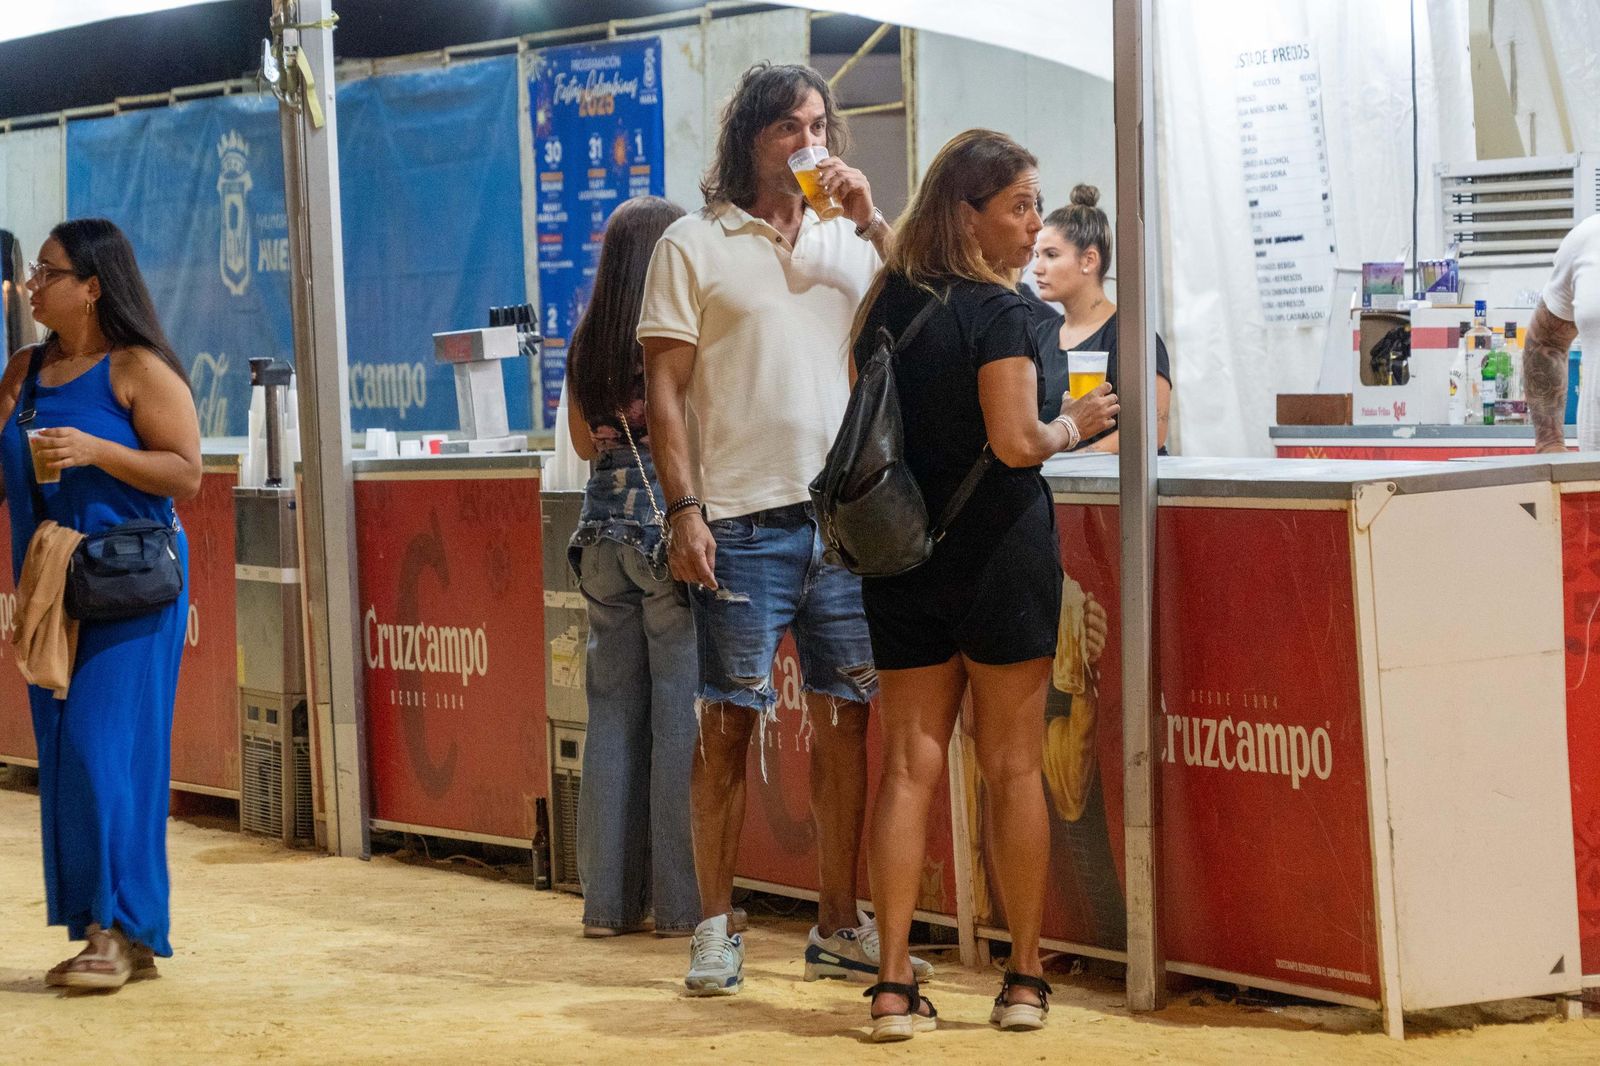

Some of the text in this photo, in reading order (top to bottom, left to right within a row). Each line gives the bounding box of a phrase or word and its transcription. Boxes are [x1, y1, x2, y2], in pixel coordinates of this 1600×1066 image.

[544, 141, 562, 163] 30
[588, 136, 603, 160] 31
[634, 133, 643, 156] 1
[547, 307, 558, 329] 2
[364, 604, 488, 687] Cruzcampo
[1191, 689, 1231, 706] DESDE
[1161, 692, 1333, 790] ruzcampo
